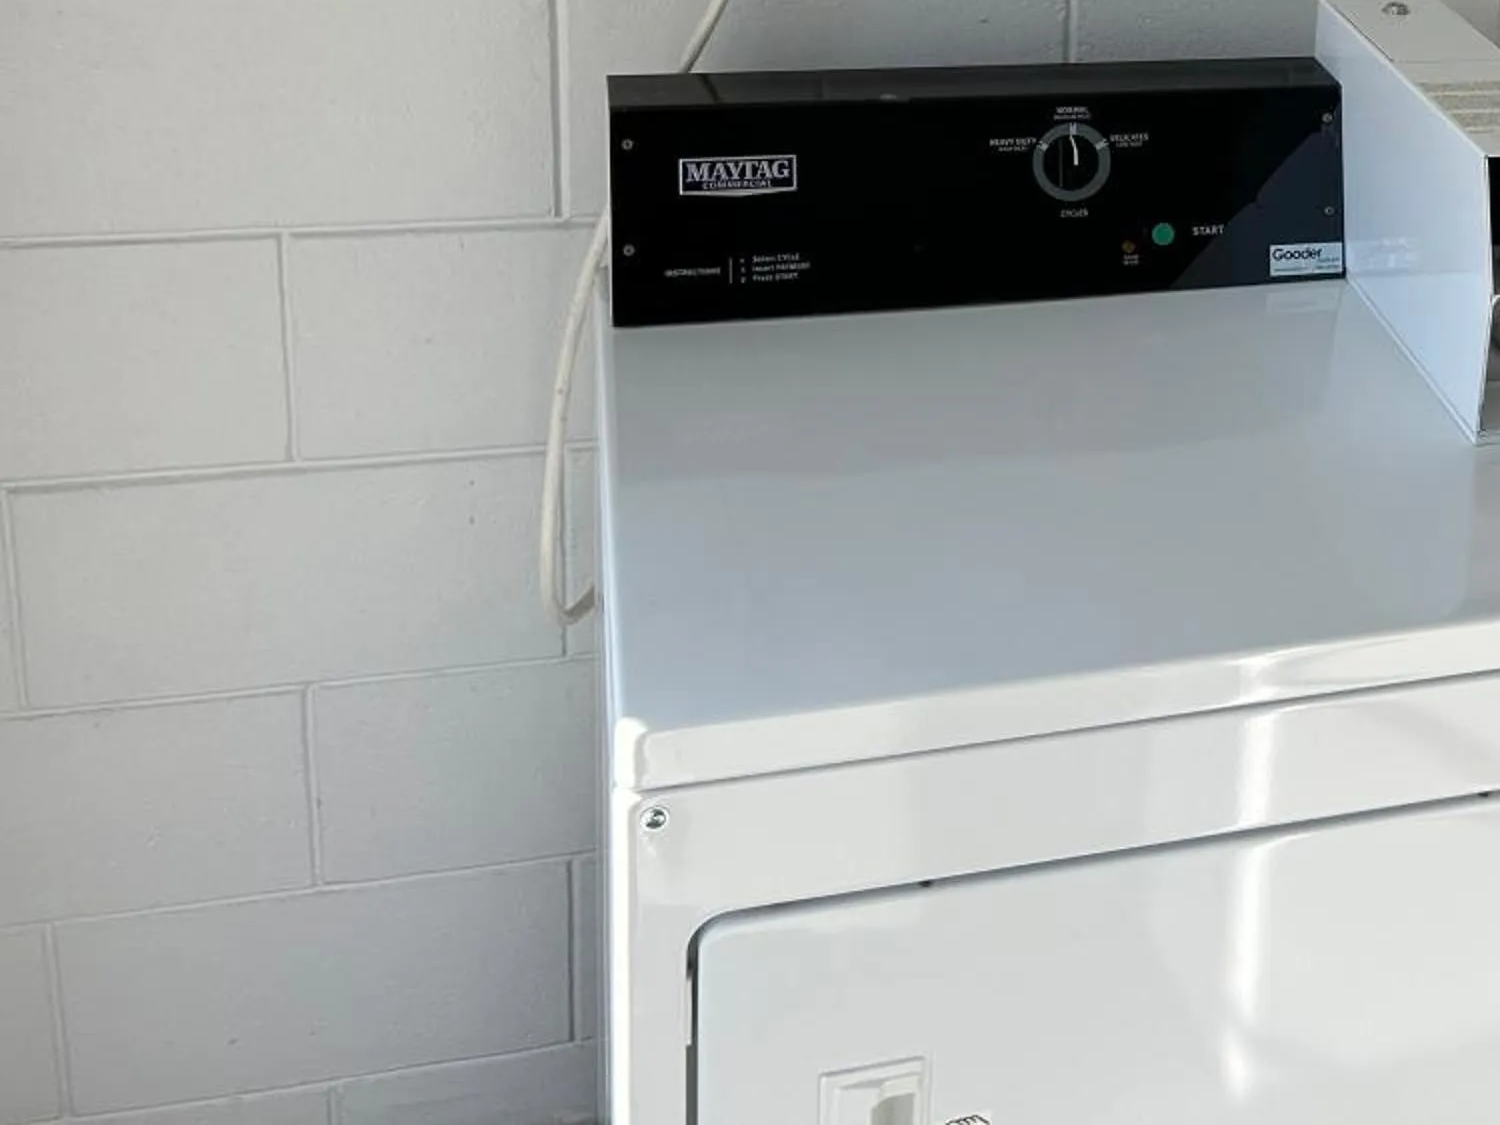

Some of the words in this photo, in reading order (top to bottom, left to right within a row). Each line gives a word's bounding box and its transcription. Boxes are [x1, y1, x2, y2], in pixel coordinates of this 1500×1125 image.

[685, 160, 790, 183] MAYTAG
[703, 180, 772, 190] COMMERCIAL
[1192, 225, 1225, 236] START
[1272, 246, 1323, 262] Gooder
